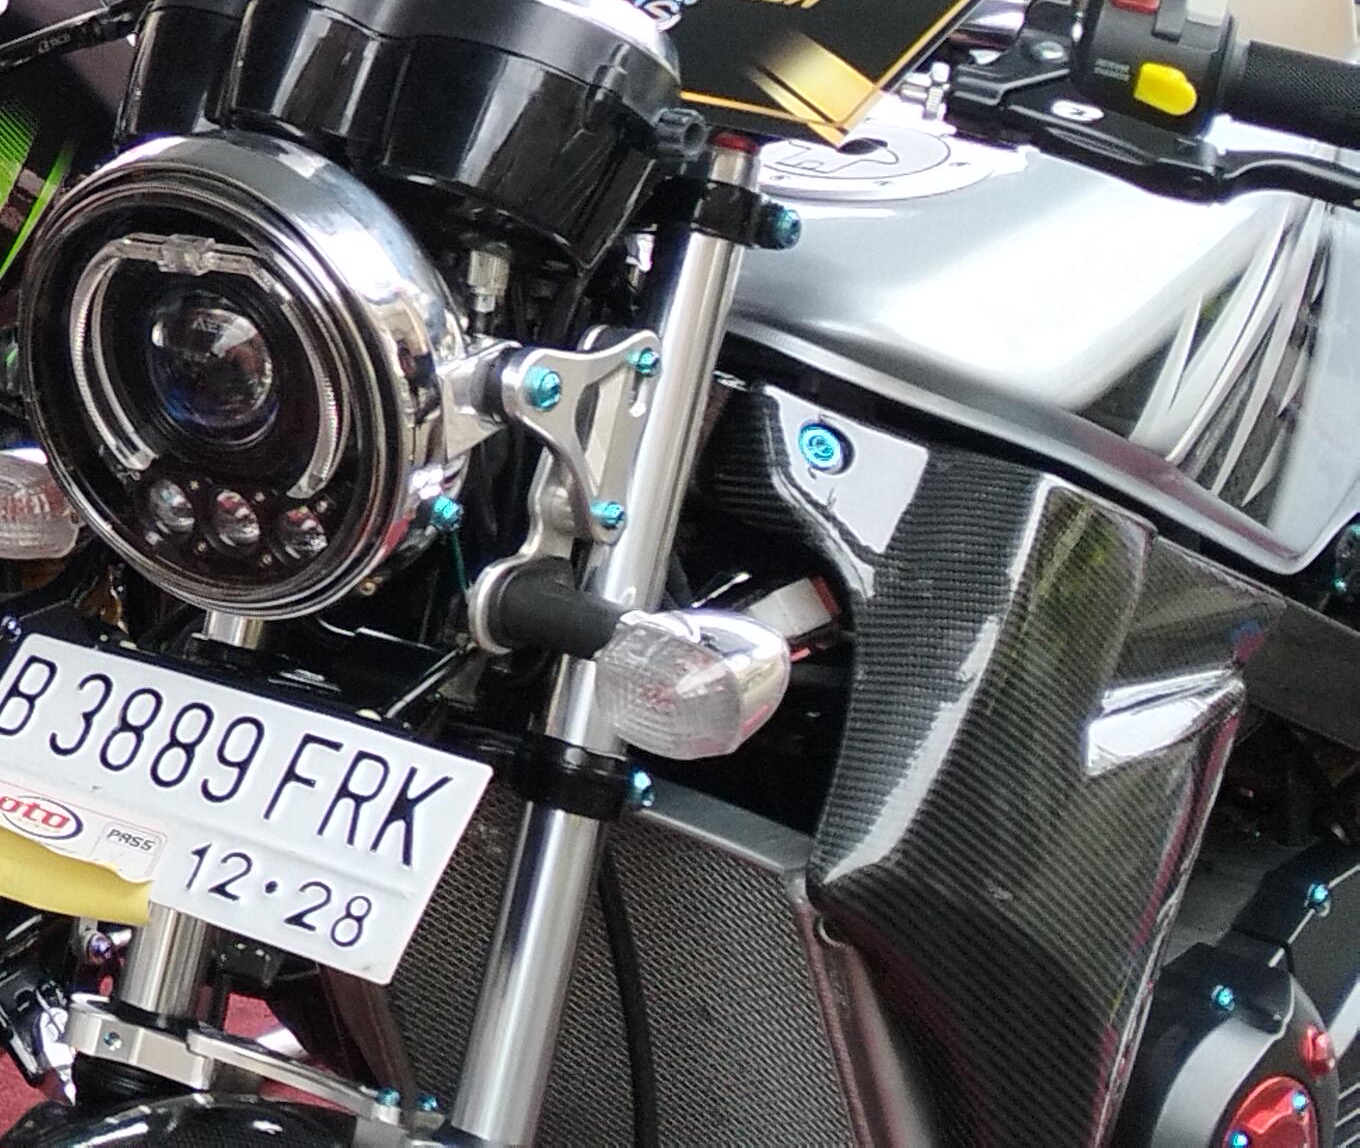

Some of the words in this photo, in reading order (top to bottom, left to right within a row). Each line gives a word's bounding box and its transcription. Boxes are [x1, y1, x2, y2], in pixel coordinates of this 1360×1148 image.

[48, 672, 266, 805] 3889
[262, 732, 454, 869] FRK
[106, 828, 156, 852] PASS
